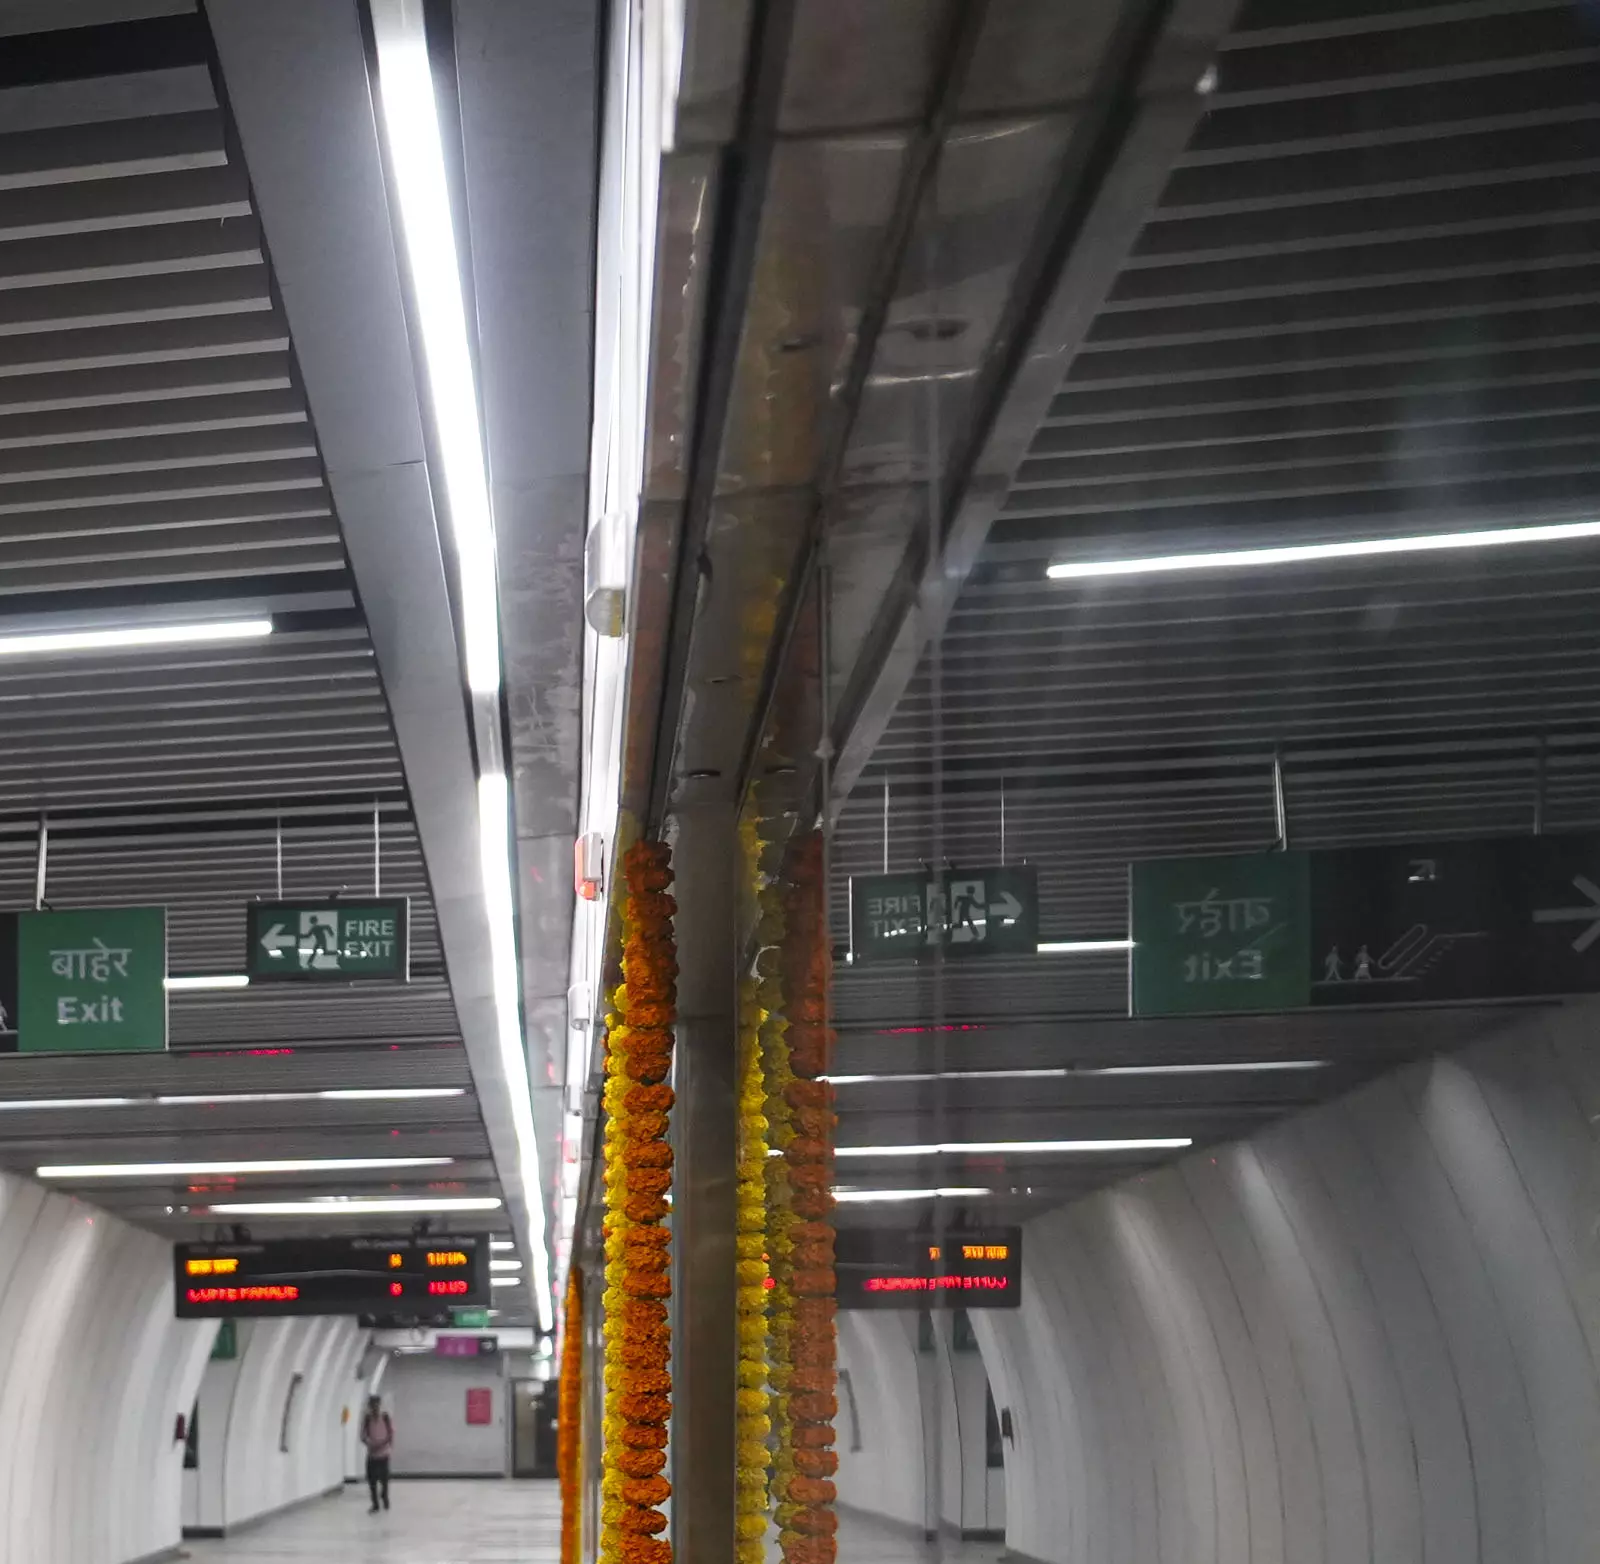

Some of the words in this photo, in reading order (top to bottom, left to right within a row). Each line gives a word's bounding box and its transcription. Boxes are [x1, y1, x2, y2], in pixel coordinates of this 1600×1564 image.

[344, 920, 395, 938] FIRE
[49, 938, 132, 982] बाहेर
[344, 940, 395, 959] EXIT
[57, 995, 125, 1024] Exit
